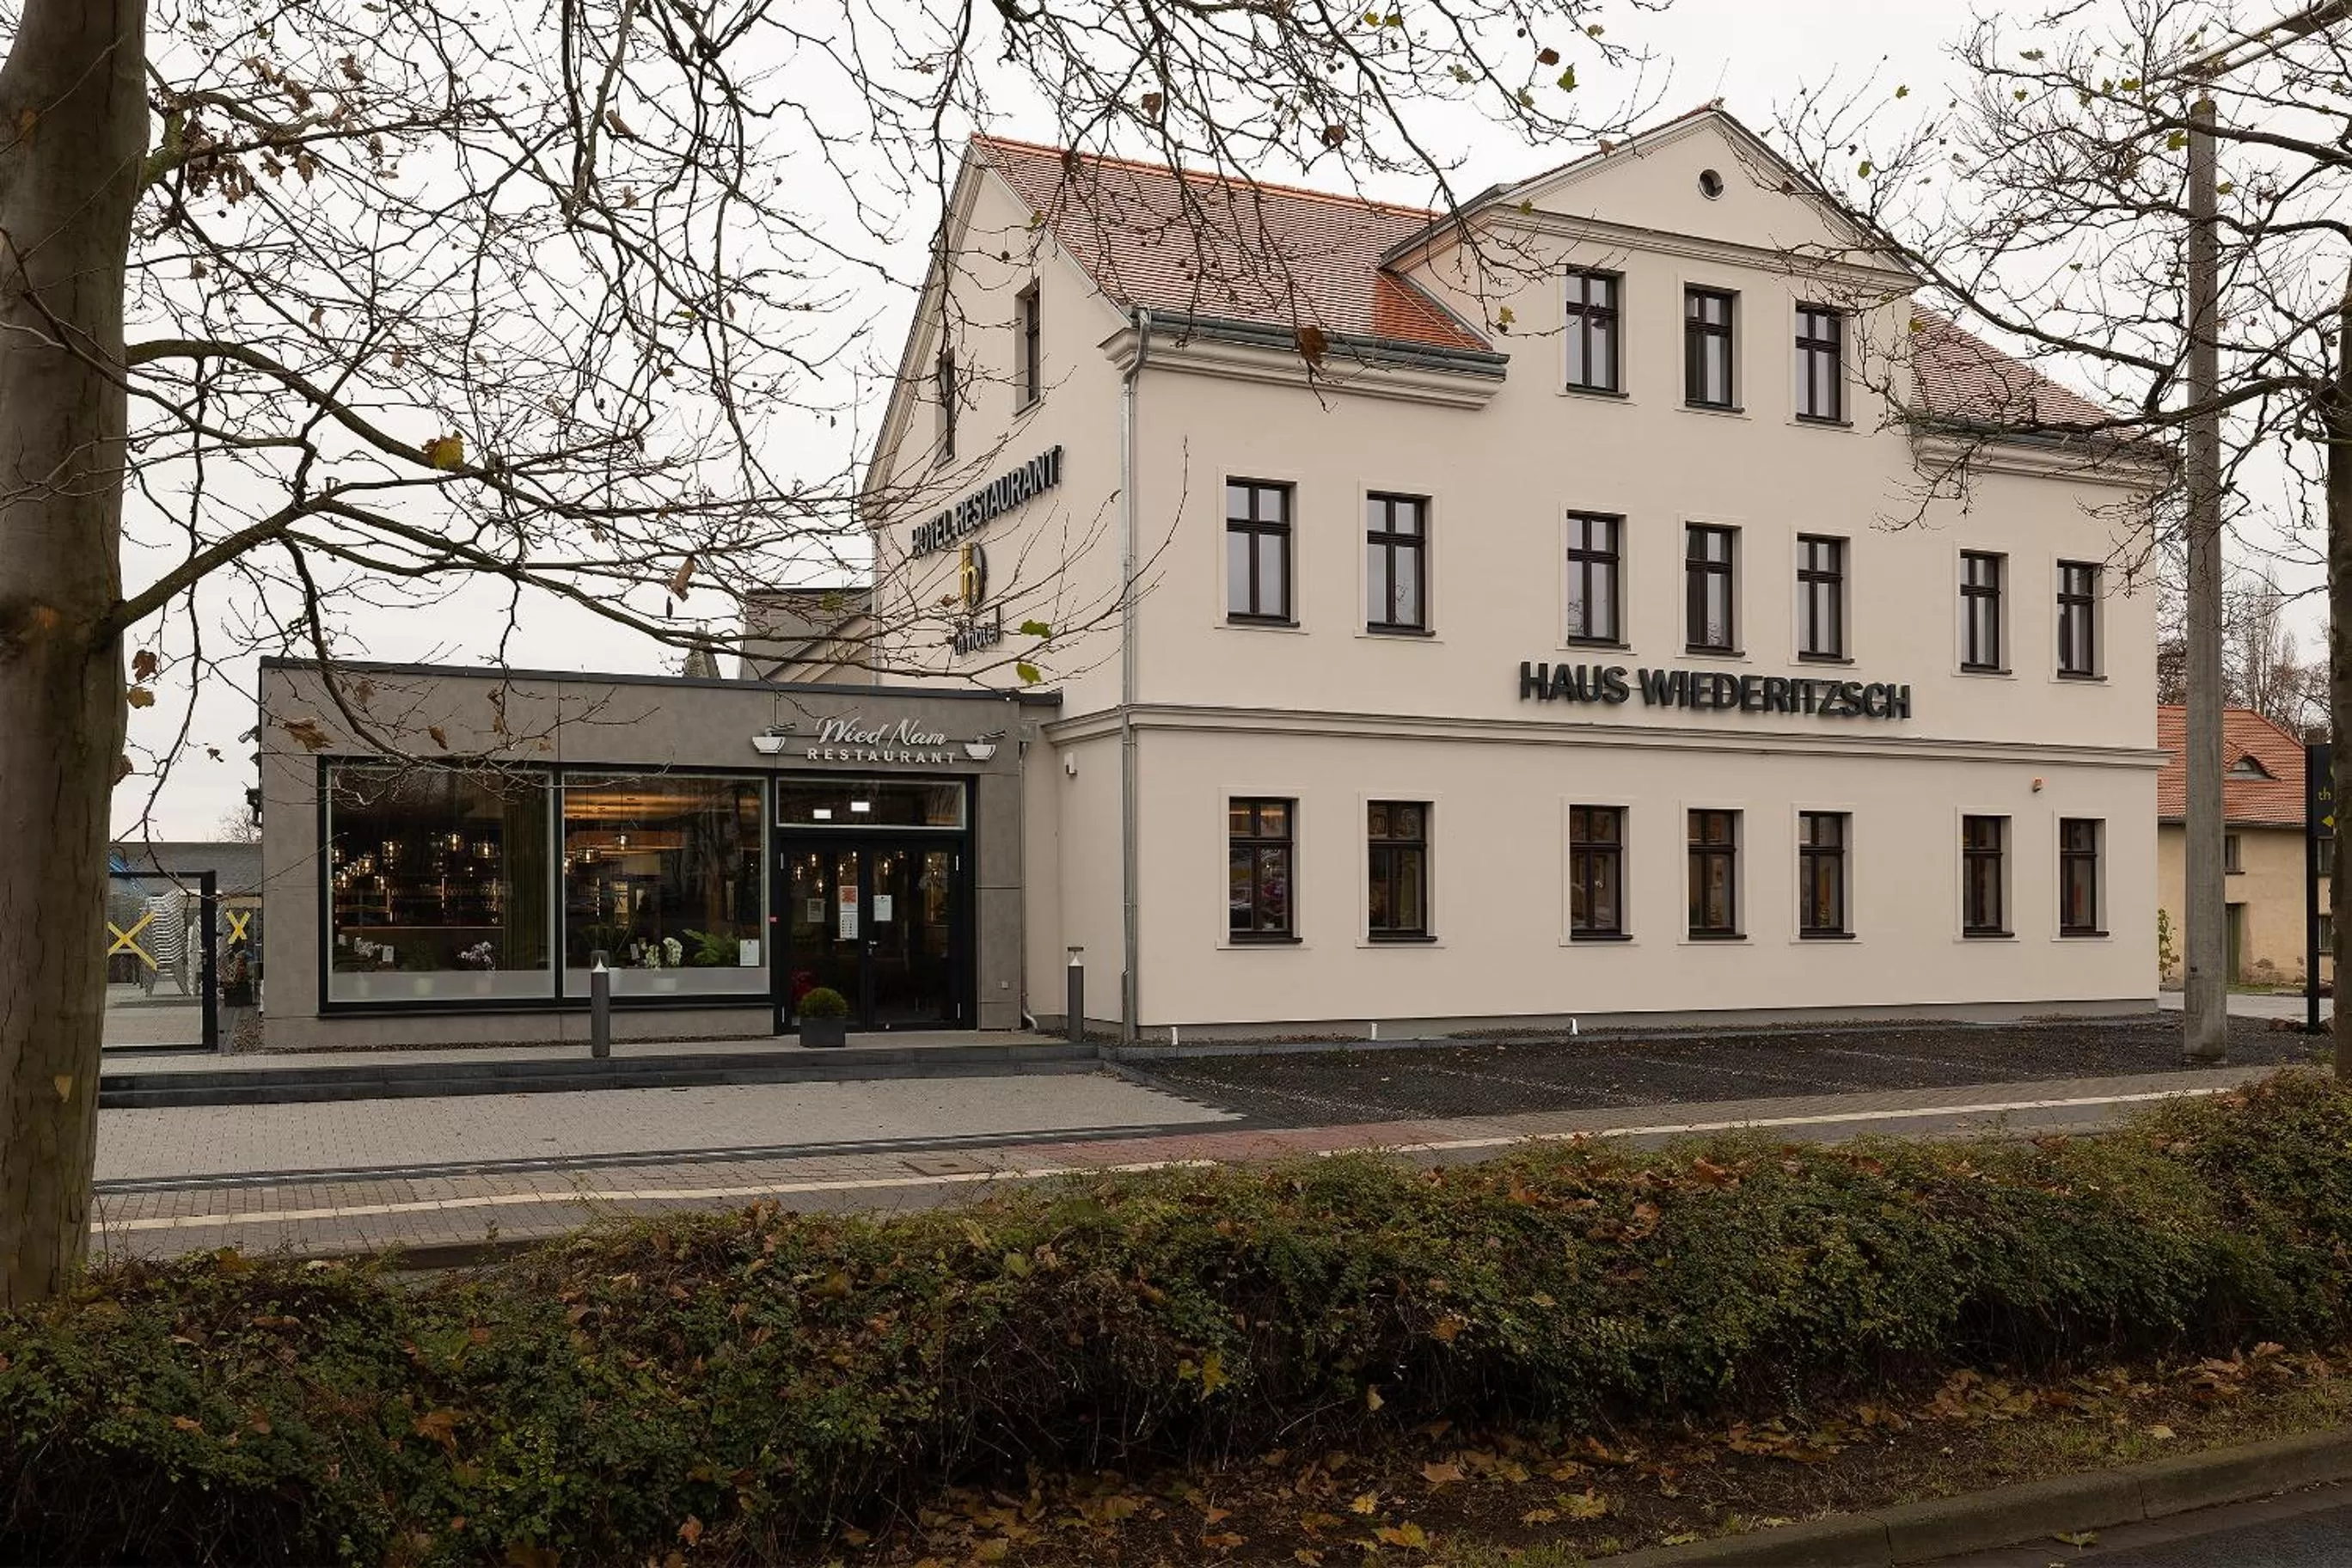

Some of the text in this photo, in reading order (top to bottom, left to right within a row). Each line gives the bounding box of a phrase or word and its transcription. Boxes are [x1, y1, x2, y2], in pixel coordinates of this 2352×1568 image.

[1519, 661, 1912, 719] HAUS WIEDERITZSCH
[816, 716, 946, 749] Wied Nam
[806, 747, 956, 764] RESTAURANT
